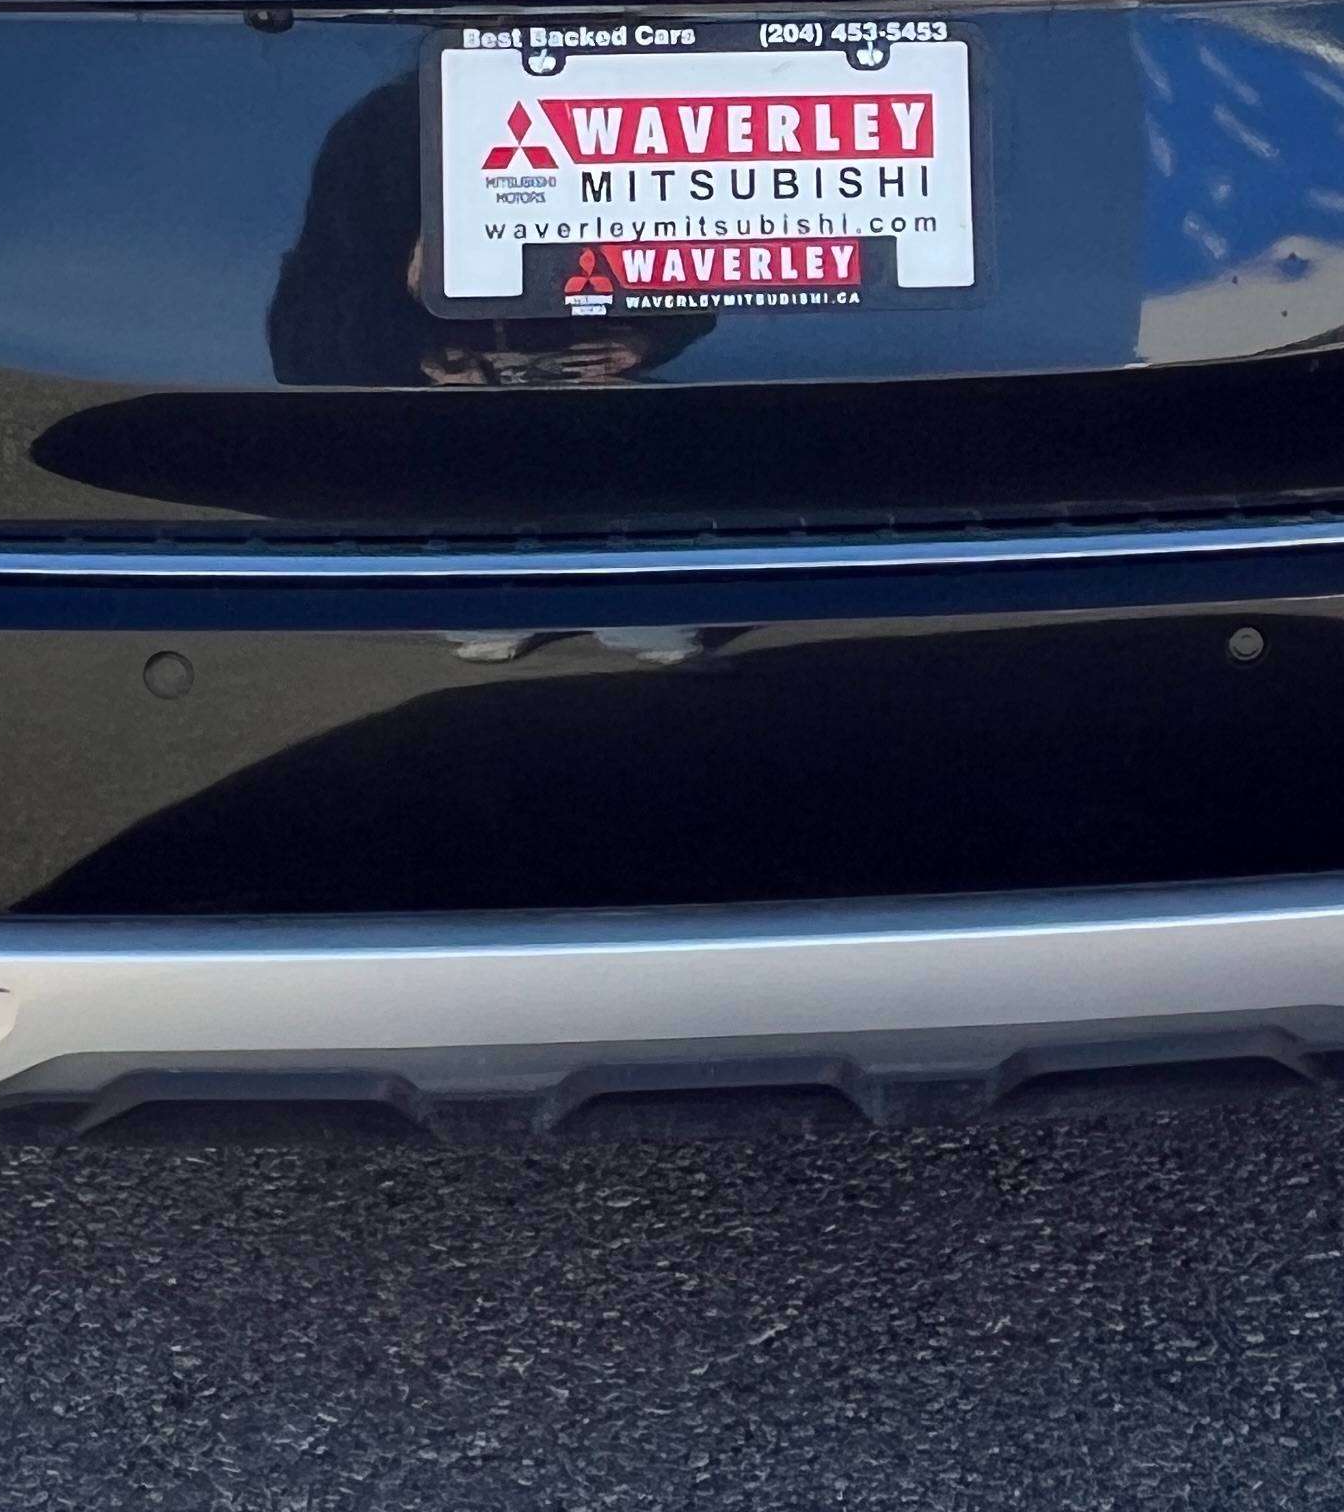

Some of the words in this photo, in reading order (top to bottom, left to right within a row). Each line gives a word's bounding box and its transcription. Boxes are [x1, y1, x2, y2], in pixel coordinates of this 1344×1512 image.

[463, 29, 522, 48] Best
[529, 26, 627, 48] Backed
[635, 25, 696, 46] Cars
[760, 22, 823, 48] (204)
[831, 21, 948, 42] 453-5453
[572, 101, 926, 155] WAVERLEY
[582, 165, 929, 203] MITSUBISHI
[485, 213, 937, 241] waverleymitsubishi.com
[622, 245, 854, 283] WAVERLEY
